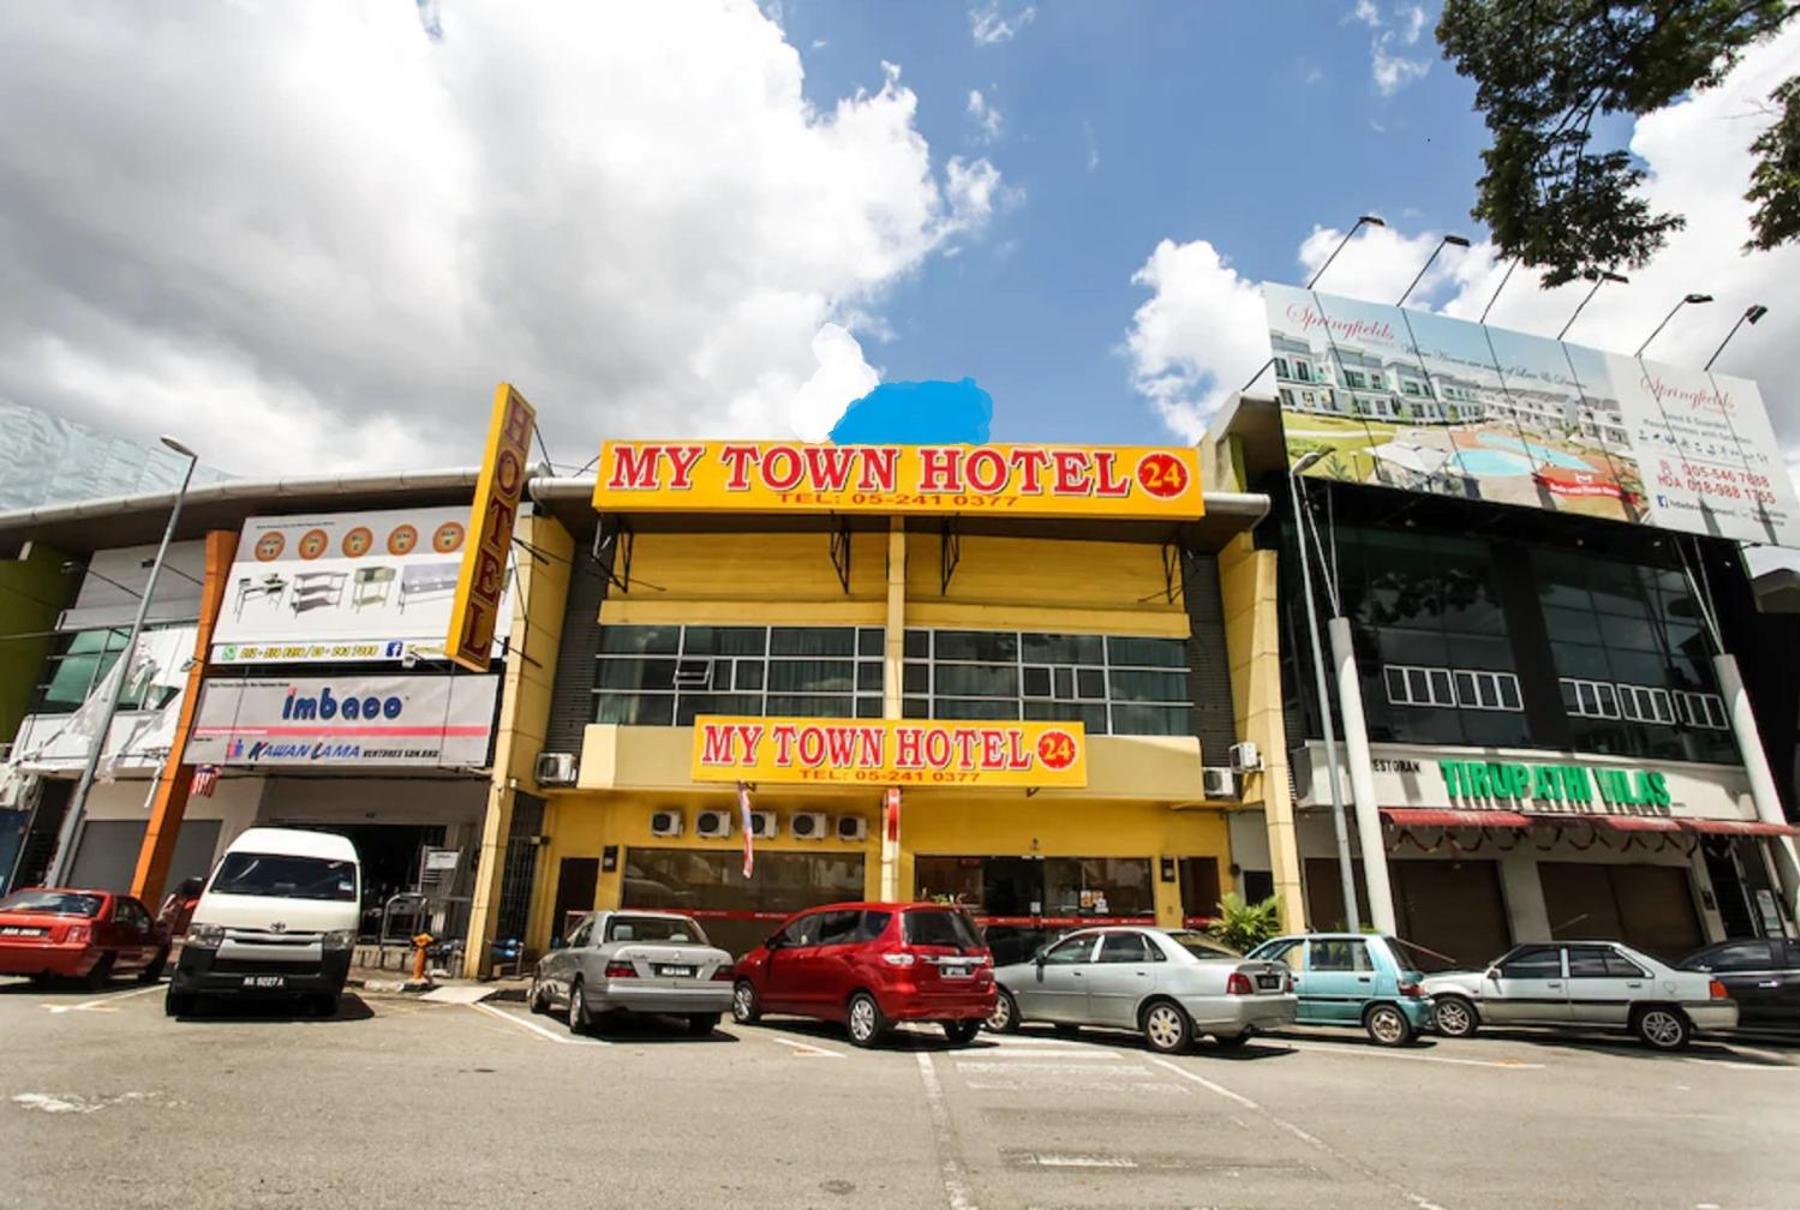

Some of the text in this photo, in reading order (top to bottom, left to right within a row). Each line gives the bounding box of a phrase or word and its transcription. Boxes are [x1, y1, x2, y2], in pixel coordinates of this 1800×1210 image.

[1286, 304, 1394, 341] Springfields
[608, 446, 1182, 496] MY TOWN HOTEL 24
[779, 492, 1018, 507] TEL: 05-241 0377
[462, 396, 530, 658] HOTEL
[702, 725, 1072, 769] MY TOWN HOTEL 24
[800, 769, 981, 783] TEL: 05-241 0377
[1373, 758, 1422, 774] ESTORAN
[1438, 759, 1593, 801] TIRUPATHI
